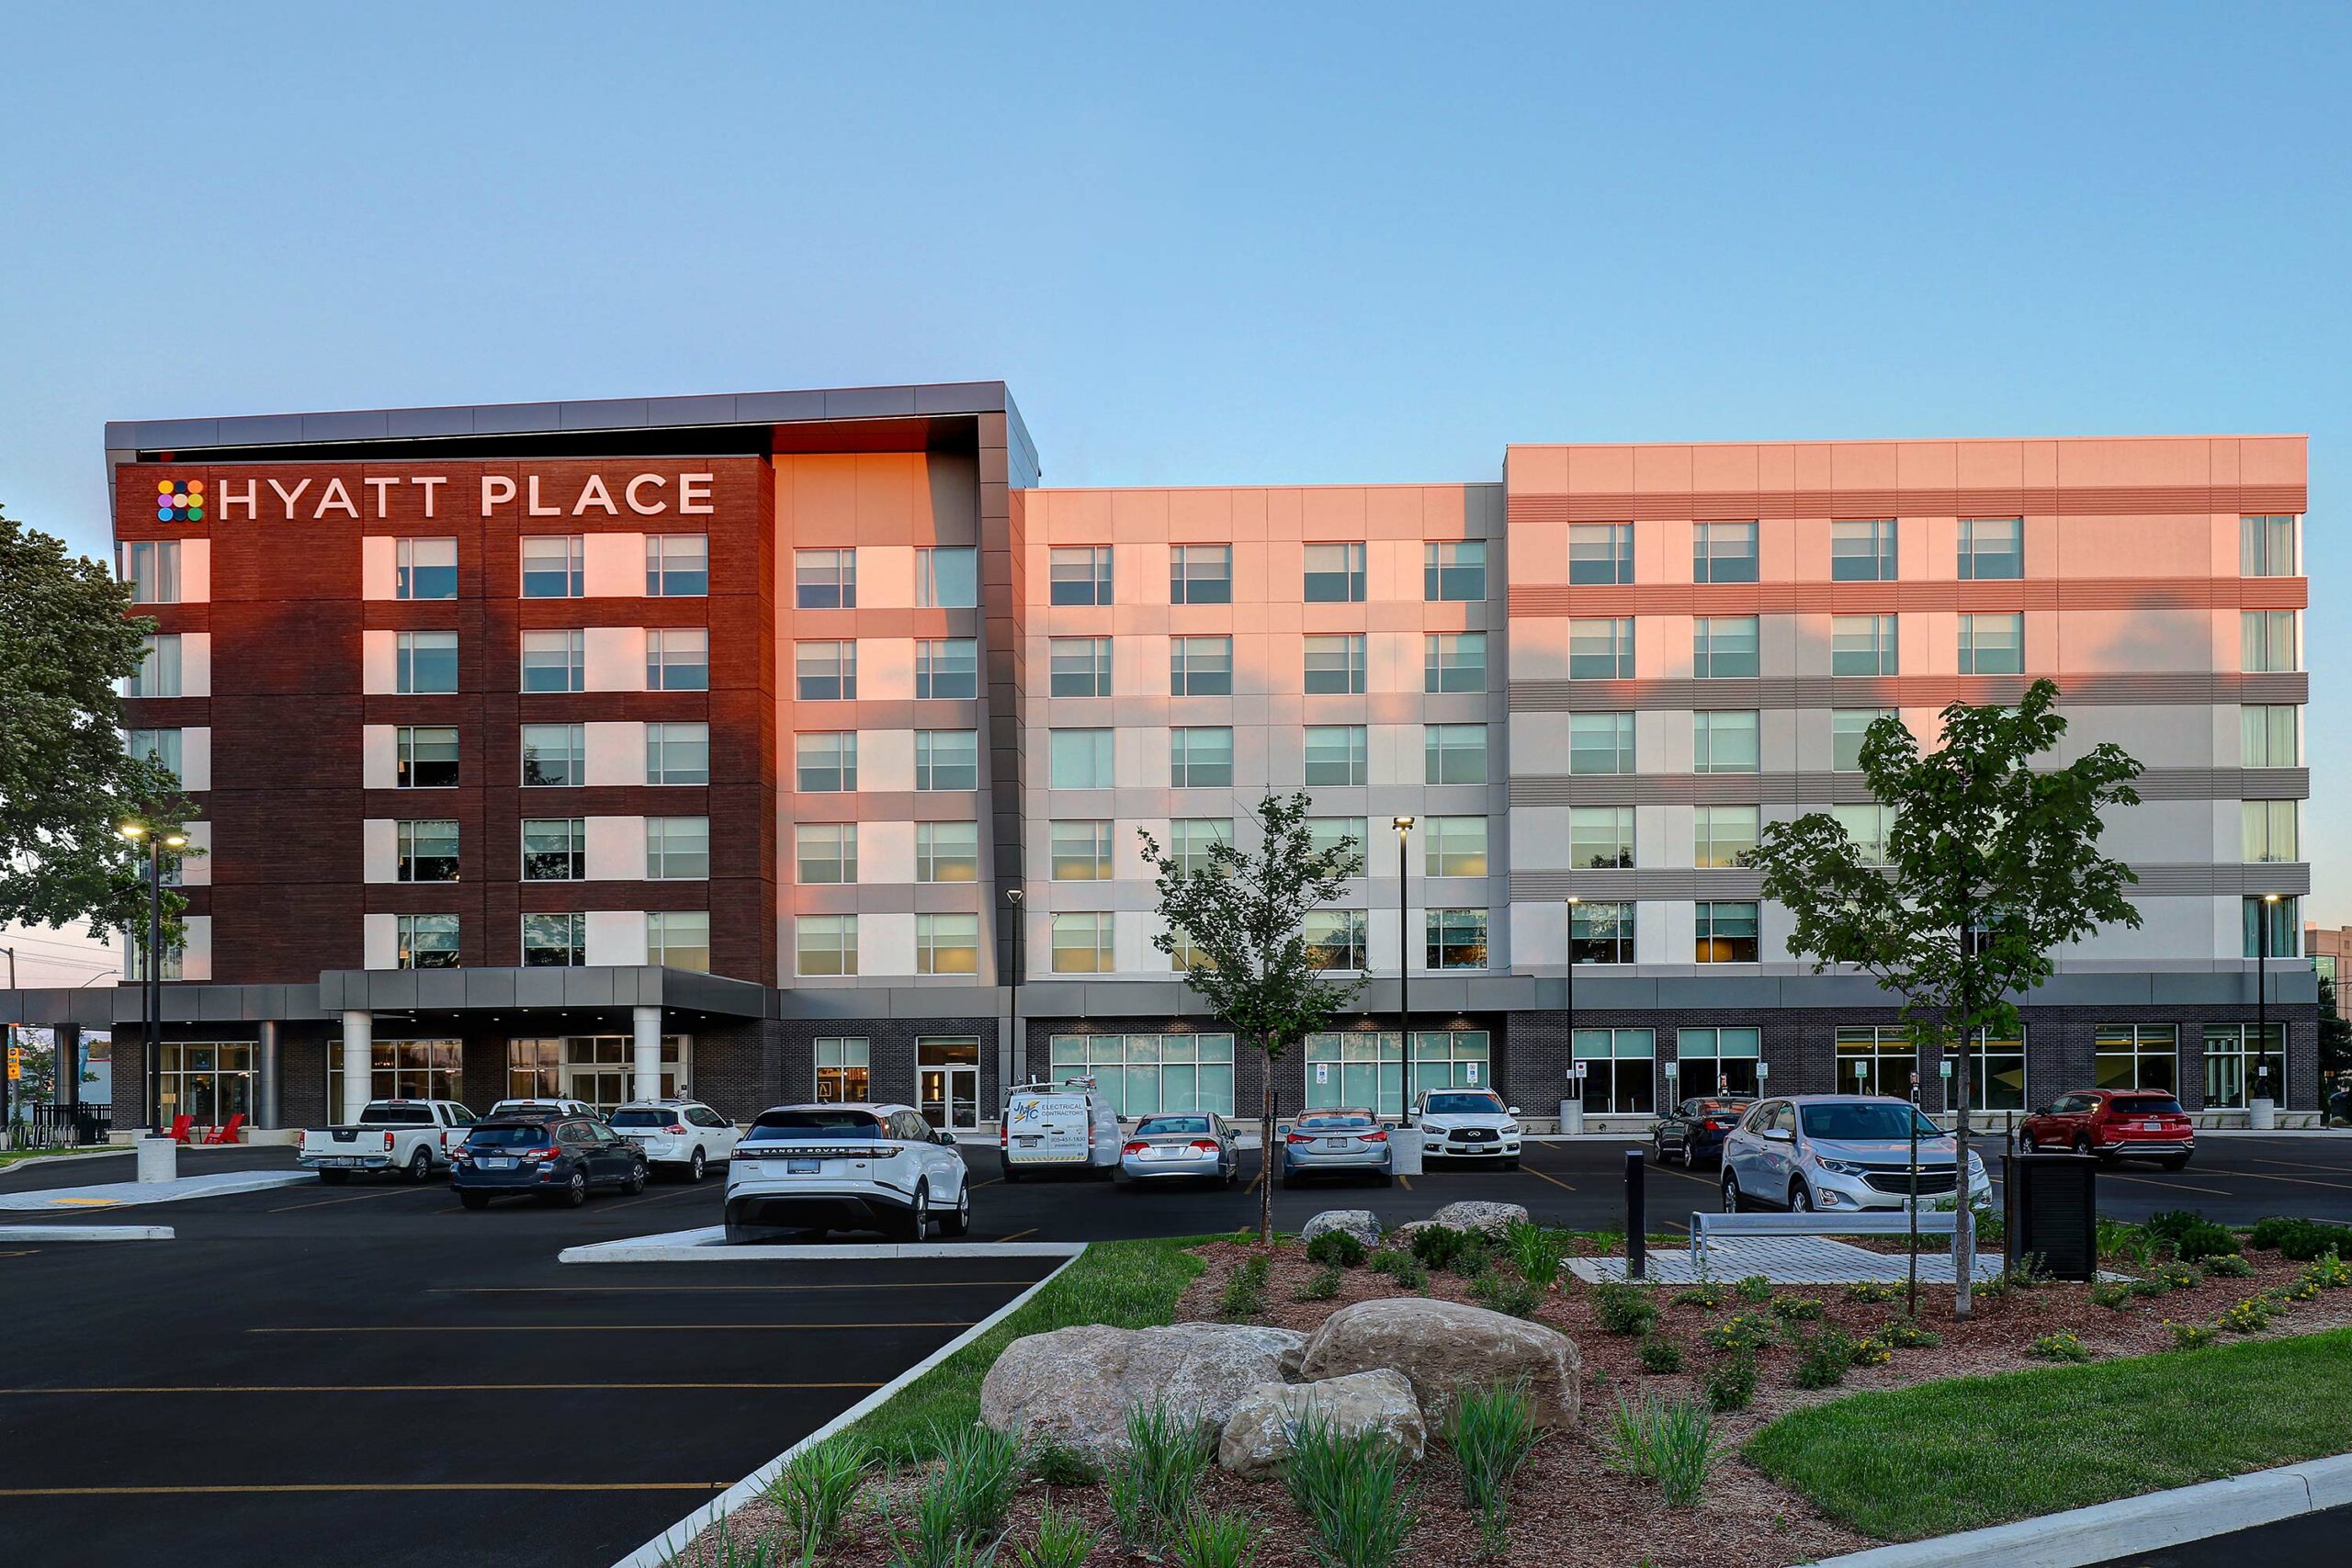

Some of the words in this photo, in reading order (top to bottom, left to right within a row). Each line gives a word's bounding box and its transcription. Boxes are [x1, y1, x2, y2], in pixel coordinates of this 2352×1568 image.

[220, 476, 447, 521] HYATT
[481, 472, 715, 517] PLACE
[1014, 1101, 1039, 1122] JMC
